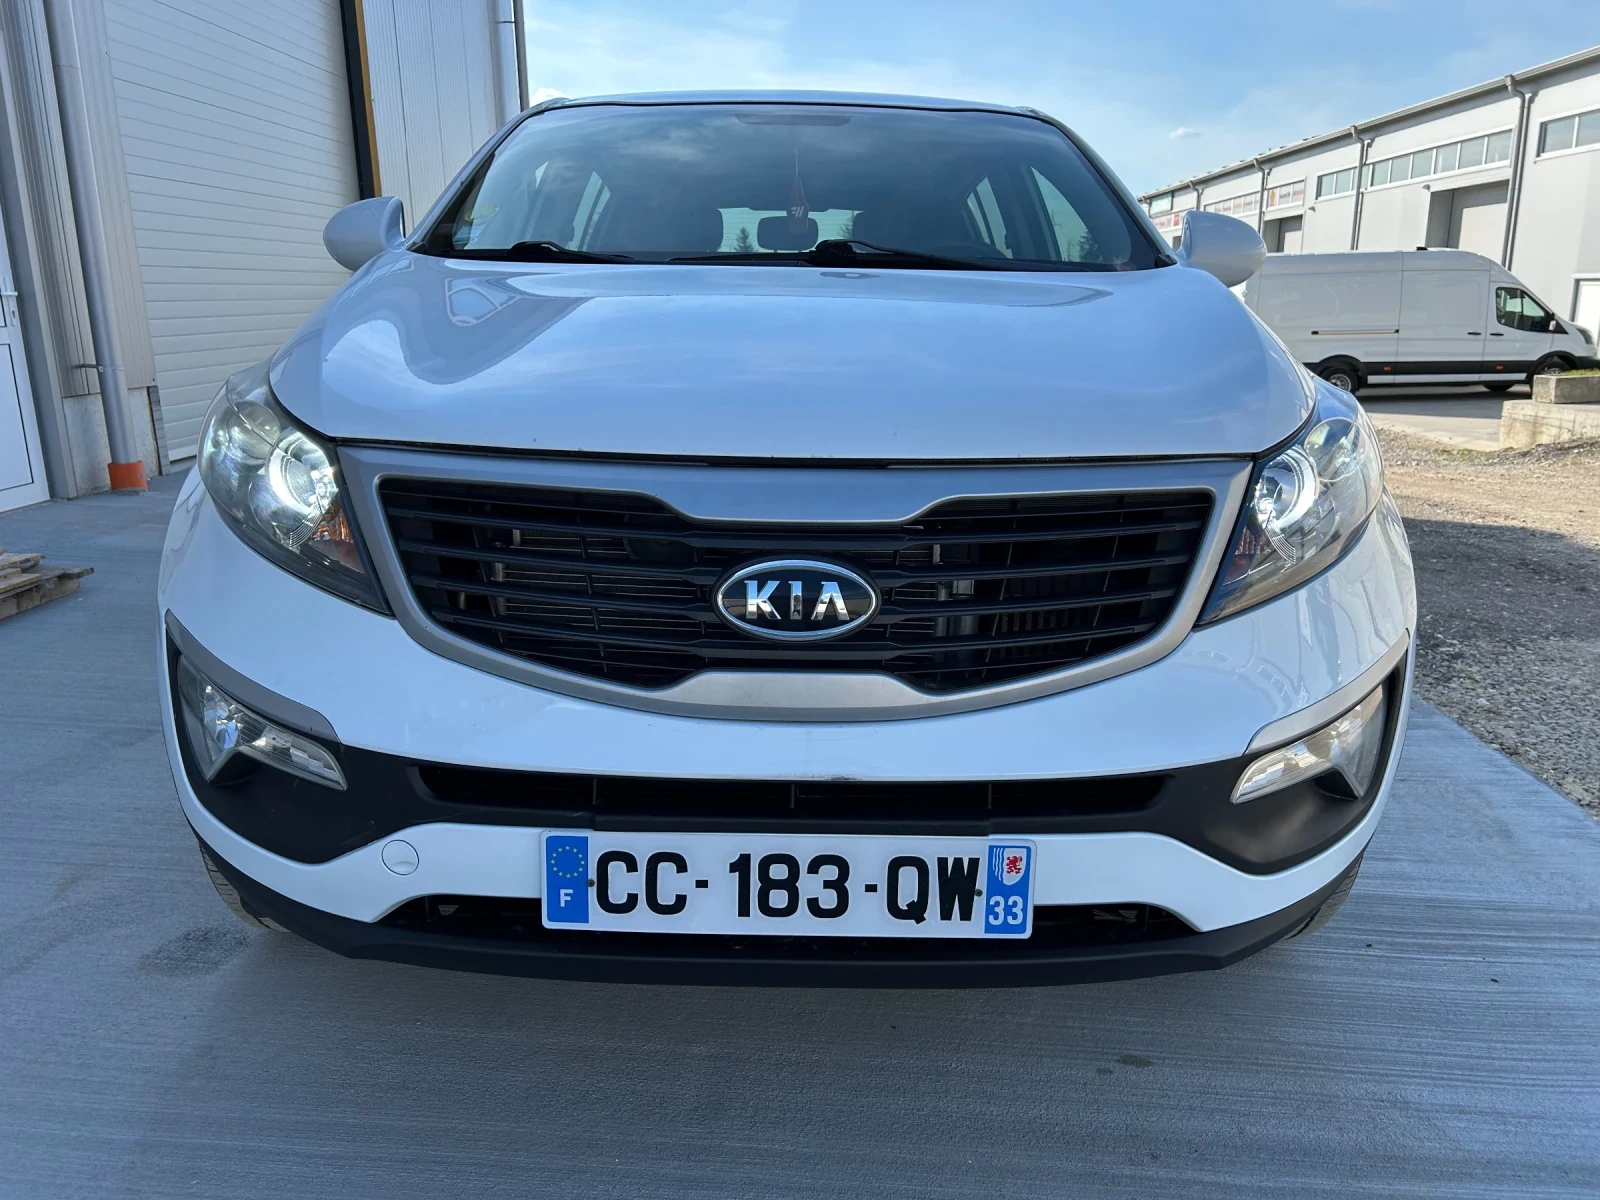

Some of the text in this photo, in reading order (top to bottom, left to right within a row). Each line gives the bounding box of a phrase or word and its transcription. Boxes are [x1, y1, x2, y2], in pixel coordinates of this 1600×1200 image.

[744, 580, 850, 620] KIA
[560, 889, 573, 908] F
[989, 895, 1024, 926] 33
